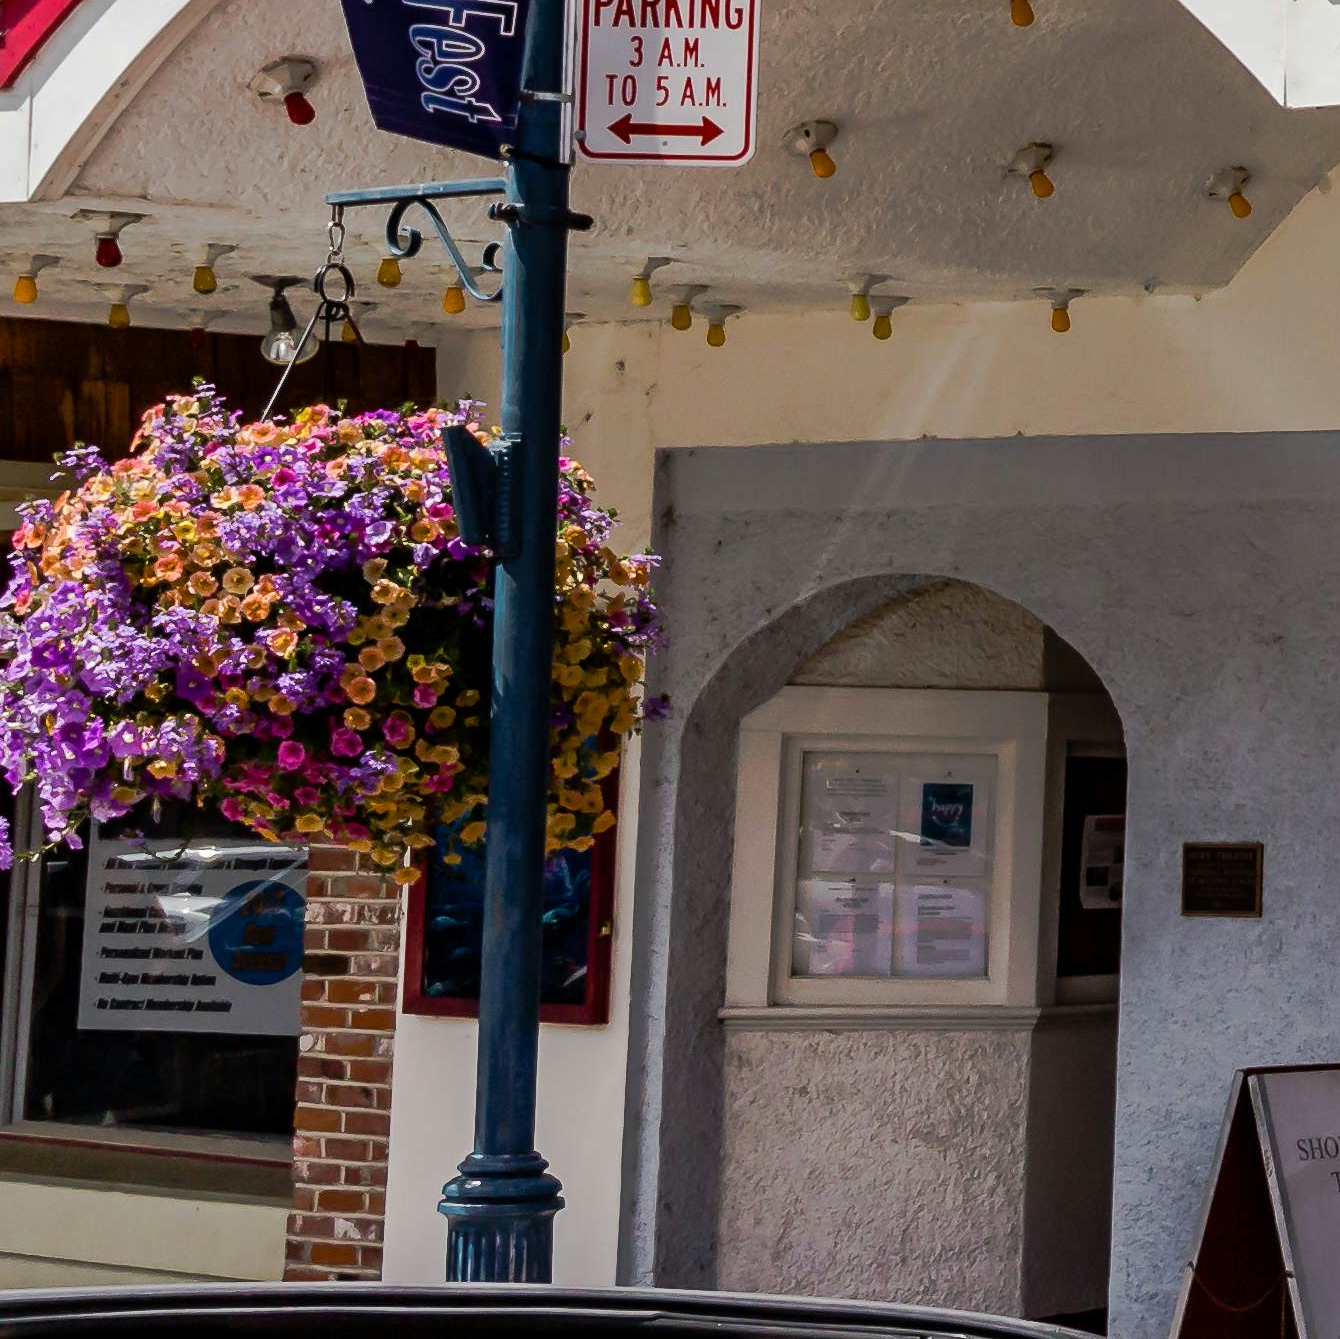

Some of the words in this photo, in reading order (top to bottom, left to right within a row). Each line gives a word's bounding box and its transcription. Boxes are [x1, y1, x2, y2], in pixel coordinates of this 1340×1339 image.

[629, 34, 644, 68] 3
[657, 36, 706, 68] A.M.
[605, 73, 638, 107] TO
[655, 75, 670, 107] 5
[680, 75, 727, 107] A.M.
